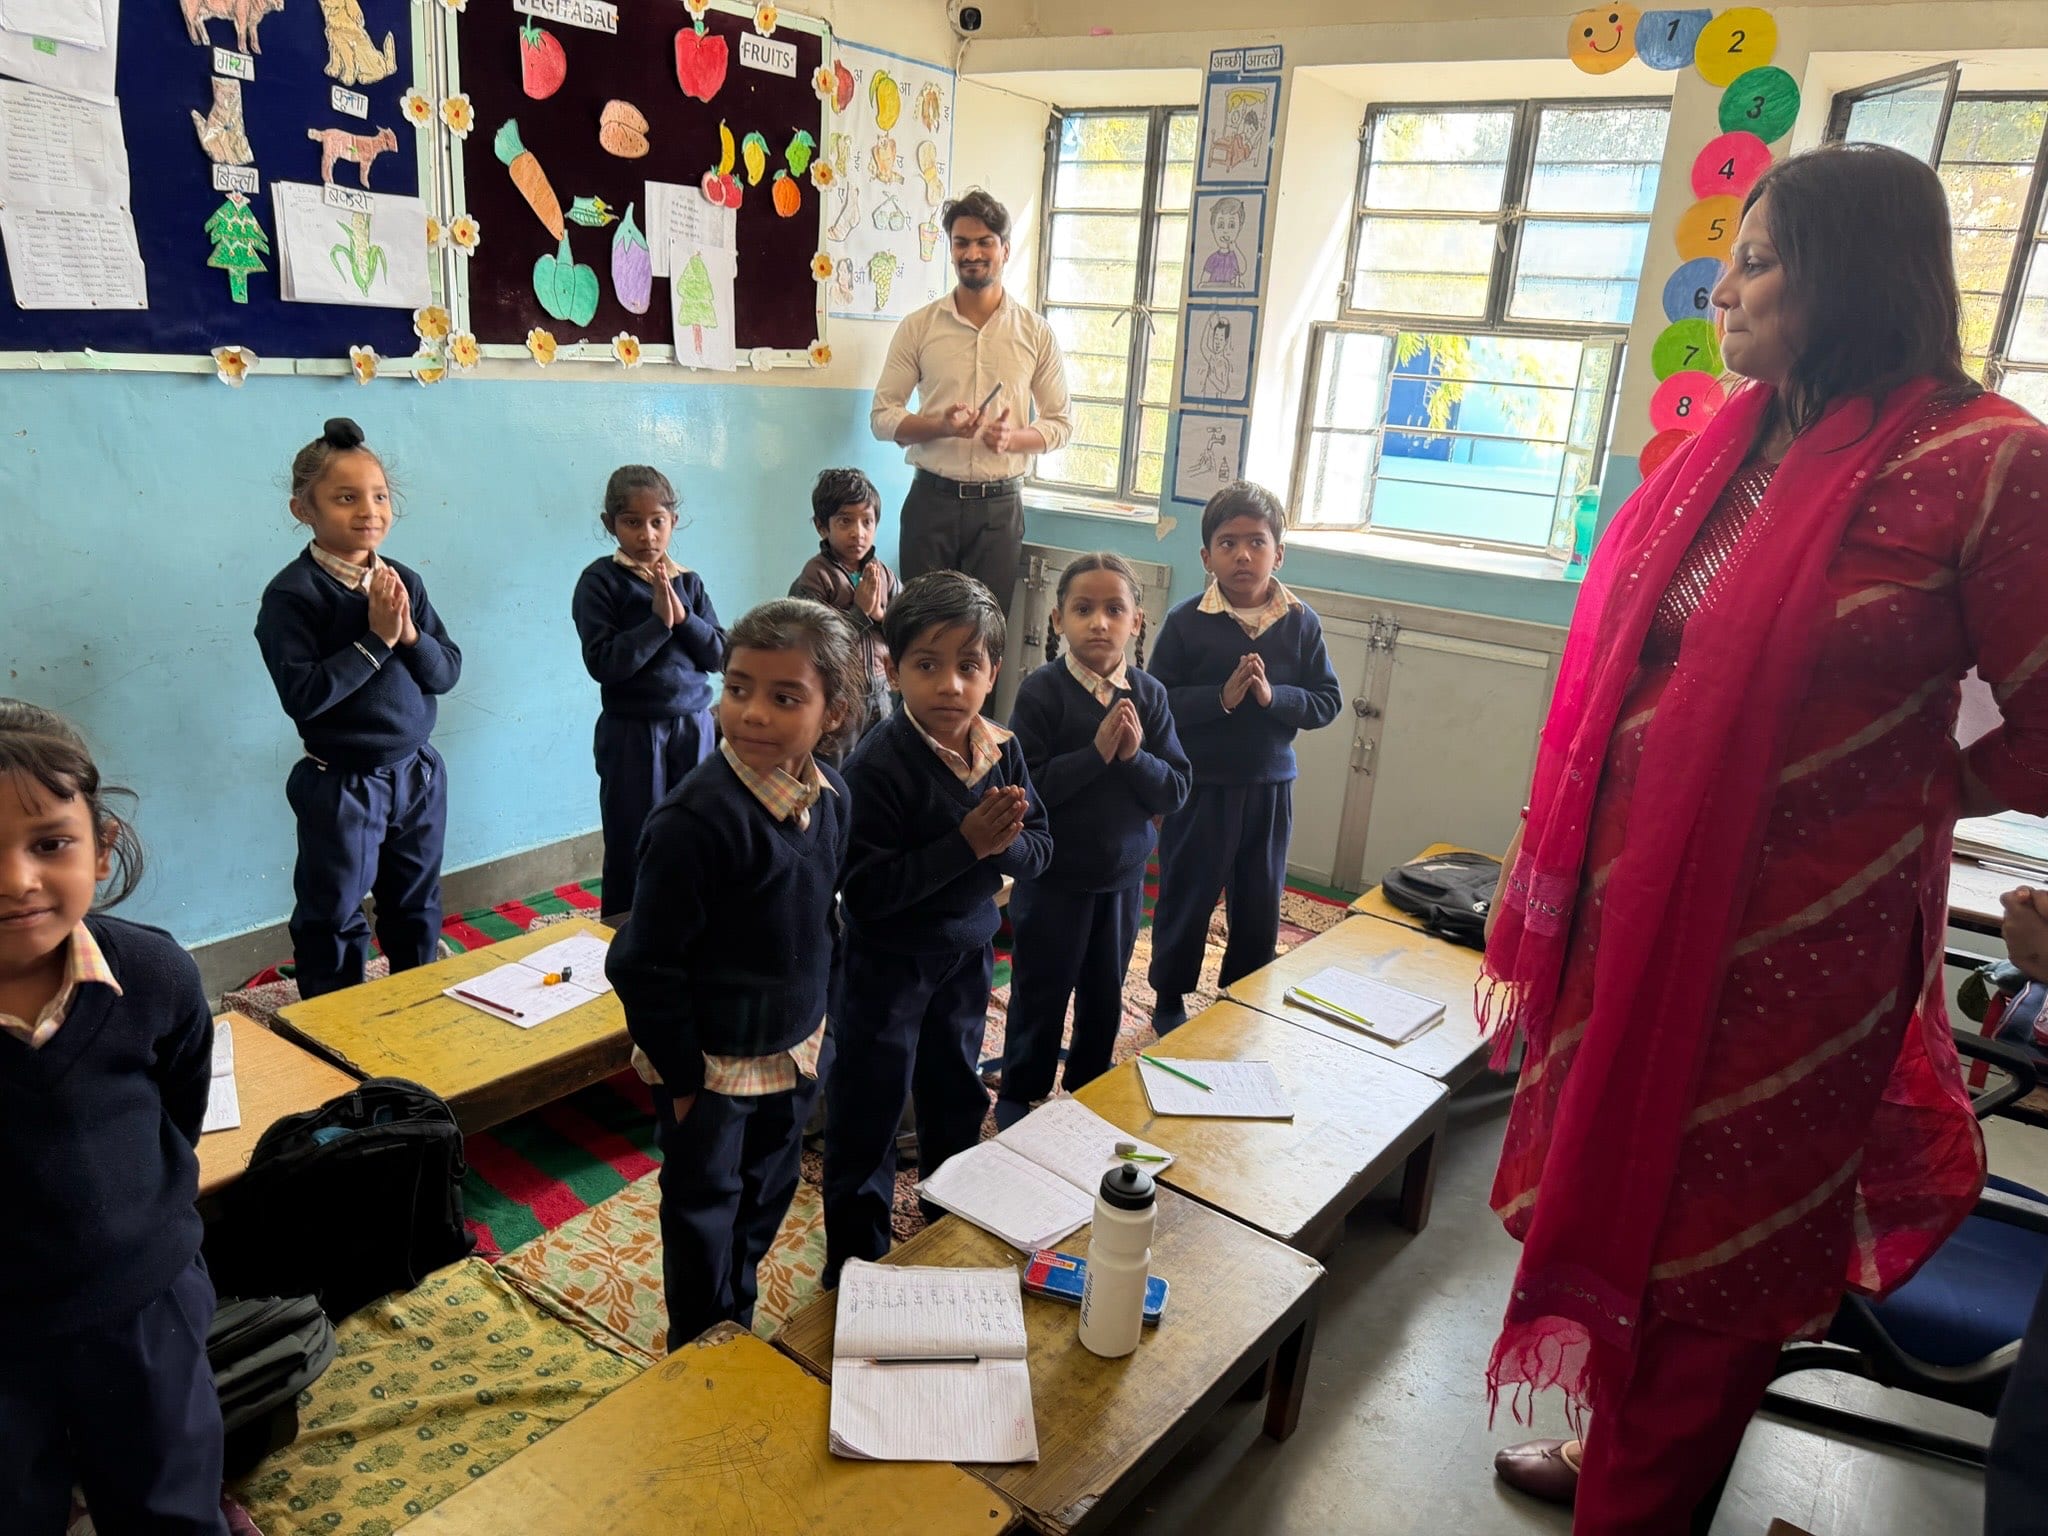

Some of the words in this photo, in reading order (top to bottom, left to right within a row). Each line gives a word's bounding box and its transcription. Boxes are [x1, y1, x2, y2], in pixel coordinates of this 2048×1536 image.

[1667, 18, 1681, 41] 1
[1727, 30, 1746, 53] 2
[216, 50, 251, 77] गाय
[743, 41, 790, 69] FRUITS
[1213, 51, 1241, 69] अच्छी
[1247, 49, 1279, 67] आदतें
[854, 68, 863, 84] अ
[899, 82, 911, 97] आ
[1746, 96, 1765, 119] 3
[216, 164, 256, 193] बिल्ली
[1717, 157, 1735, 180] 4
[1707, 218, 1727, 240] 5
[1693, 287, 1709, 310] 6
[1683, 345, 1700, 366] 7
[1676, 396, 1693, 417] 8
